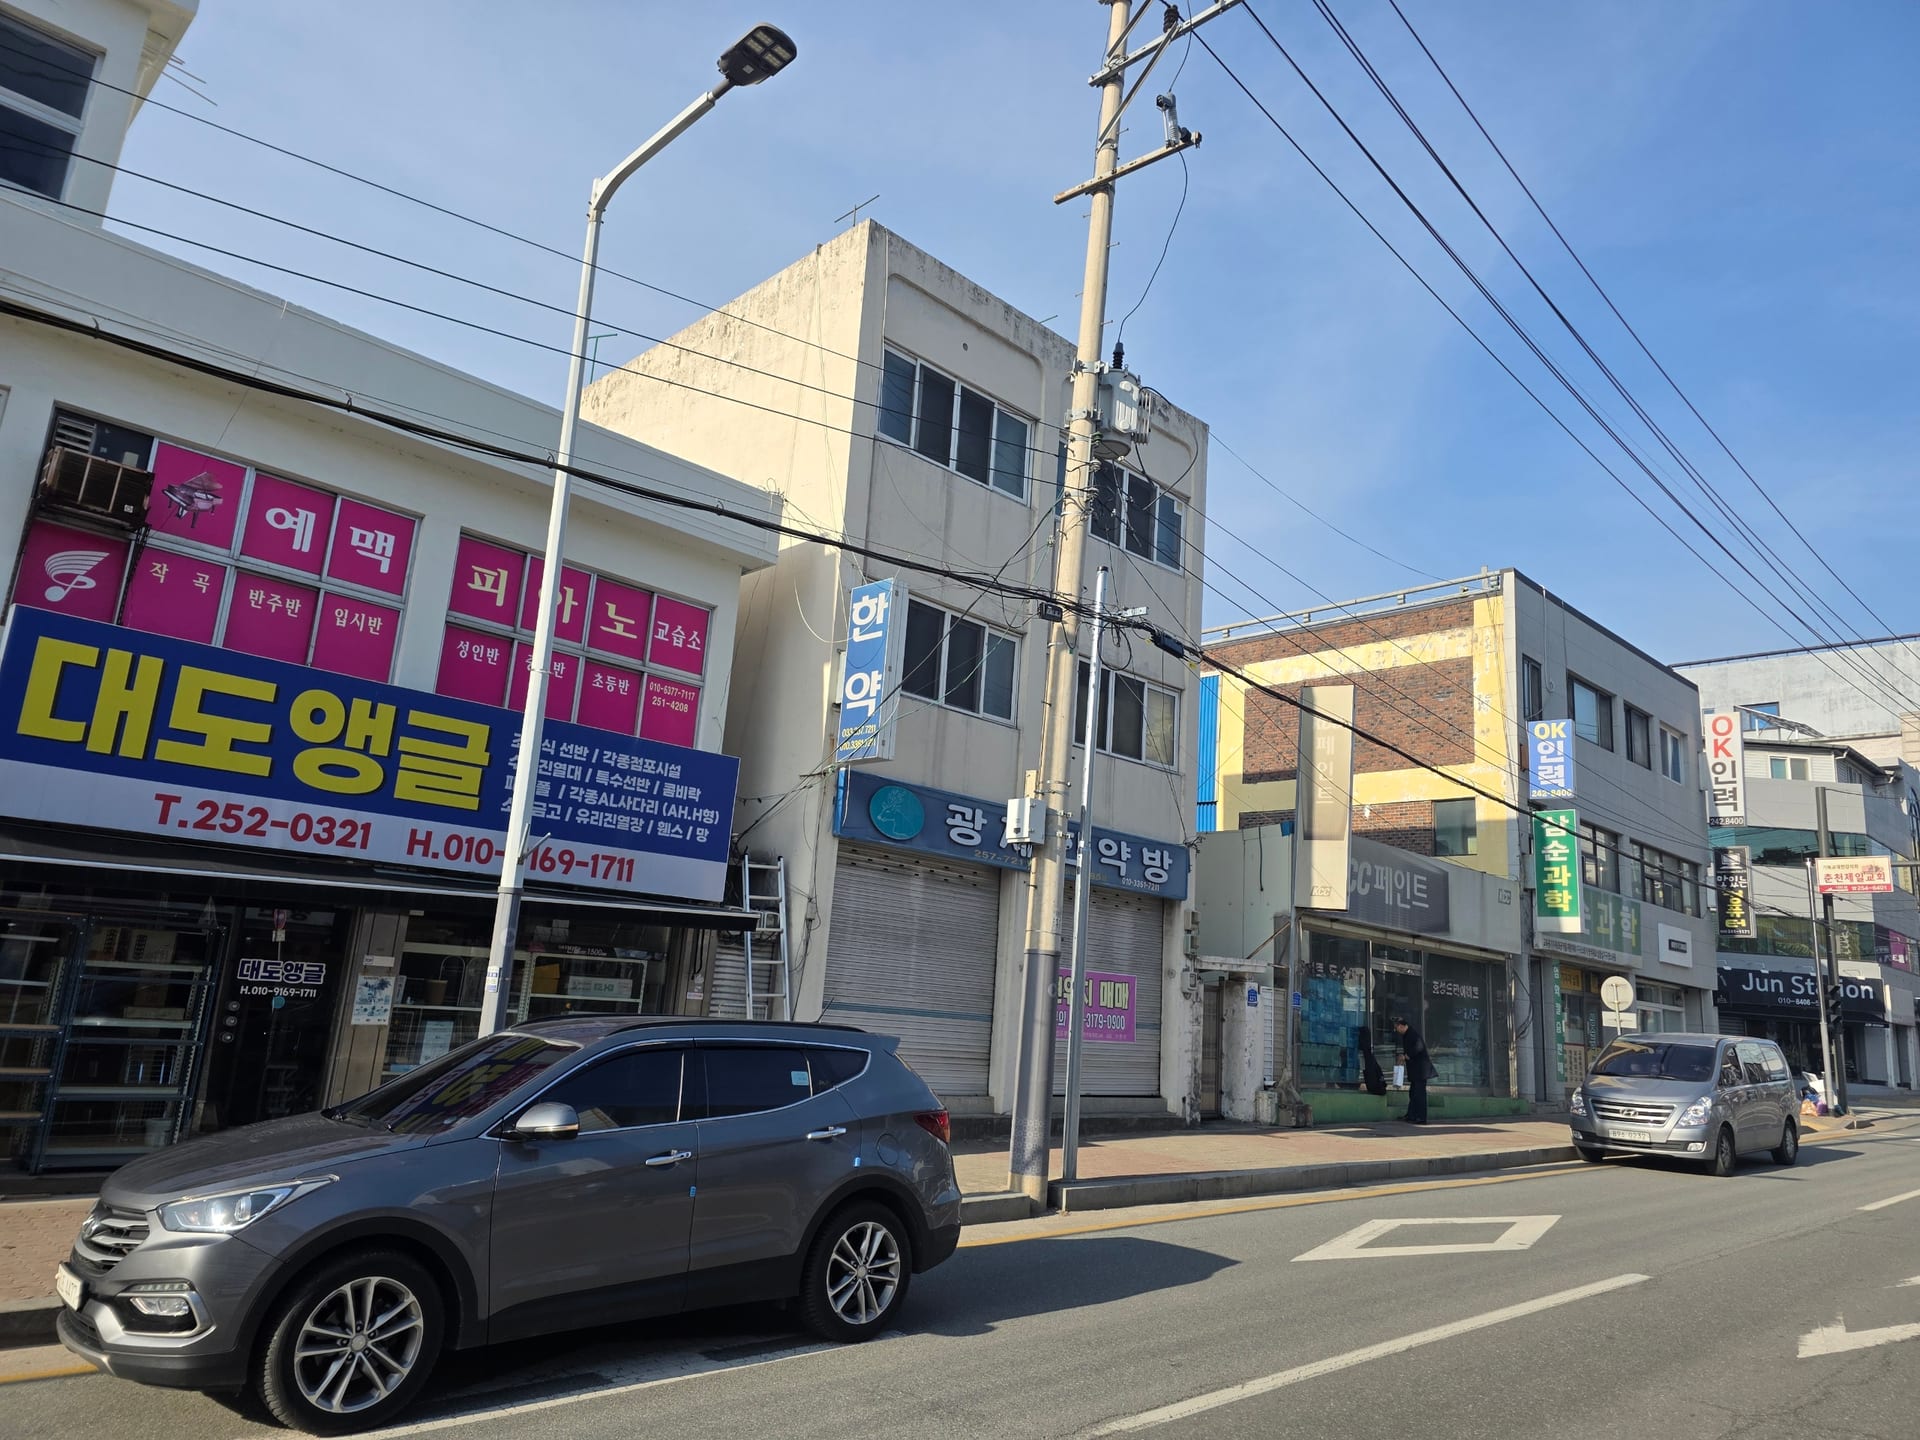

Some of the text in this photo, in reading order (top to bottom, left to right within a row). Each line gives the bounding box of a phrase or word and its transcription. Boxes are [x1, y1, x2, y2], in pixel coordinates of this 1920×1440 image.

[248, 588, 302, 618] 반주반
[334, 607, 384, 635] 입시반
[654, 621, 702, 651] 교습소
[456, 640, 500, 666] 성인반
[592, 672, 630, 696] 초등반
[17, 635, 491, 811] 대도앵글
[1534, 721, 1567, 740] OK
[511, 733, 556, 755] 조식
[559, 742, 589, 762] 선반
[602, 750, 682, 780] 각종점포시설
[508, 754, 583, 781] 수진열대
[595, 770, 651, 794] 특수선반
[662, 782, 702, 803] 콤비락
[569, 785, 659, 815] 각종AL사다리
[500, 796, 562, 820] 소금고
[575, 807, 645, 834] 유리진열장
[696, 827, 710, 844] 망
[153, 792, 635, 883] T.252-0321 H.010-169-1711
[946, 803, 1173, 883] 광약방
[1717, 875, 1748, 888] 맛있는
[1824, 871, 1886, 884] 춘천제일교회
[237, 958, 326, 984] 대도앵글
[1742, 972, 1874, 1000] Jun Stion
[239, 985, 317, 998] H.010-9169-1711
[1099, 980, 1130, 1010] 매매
